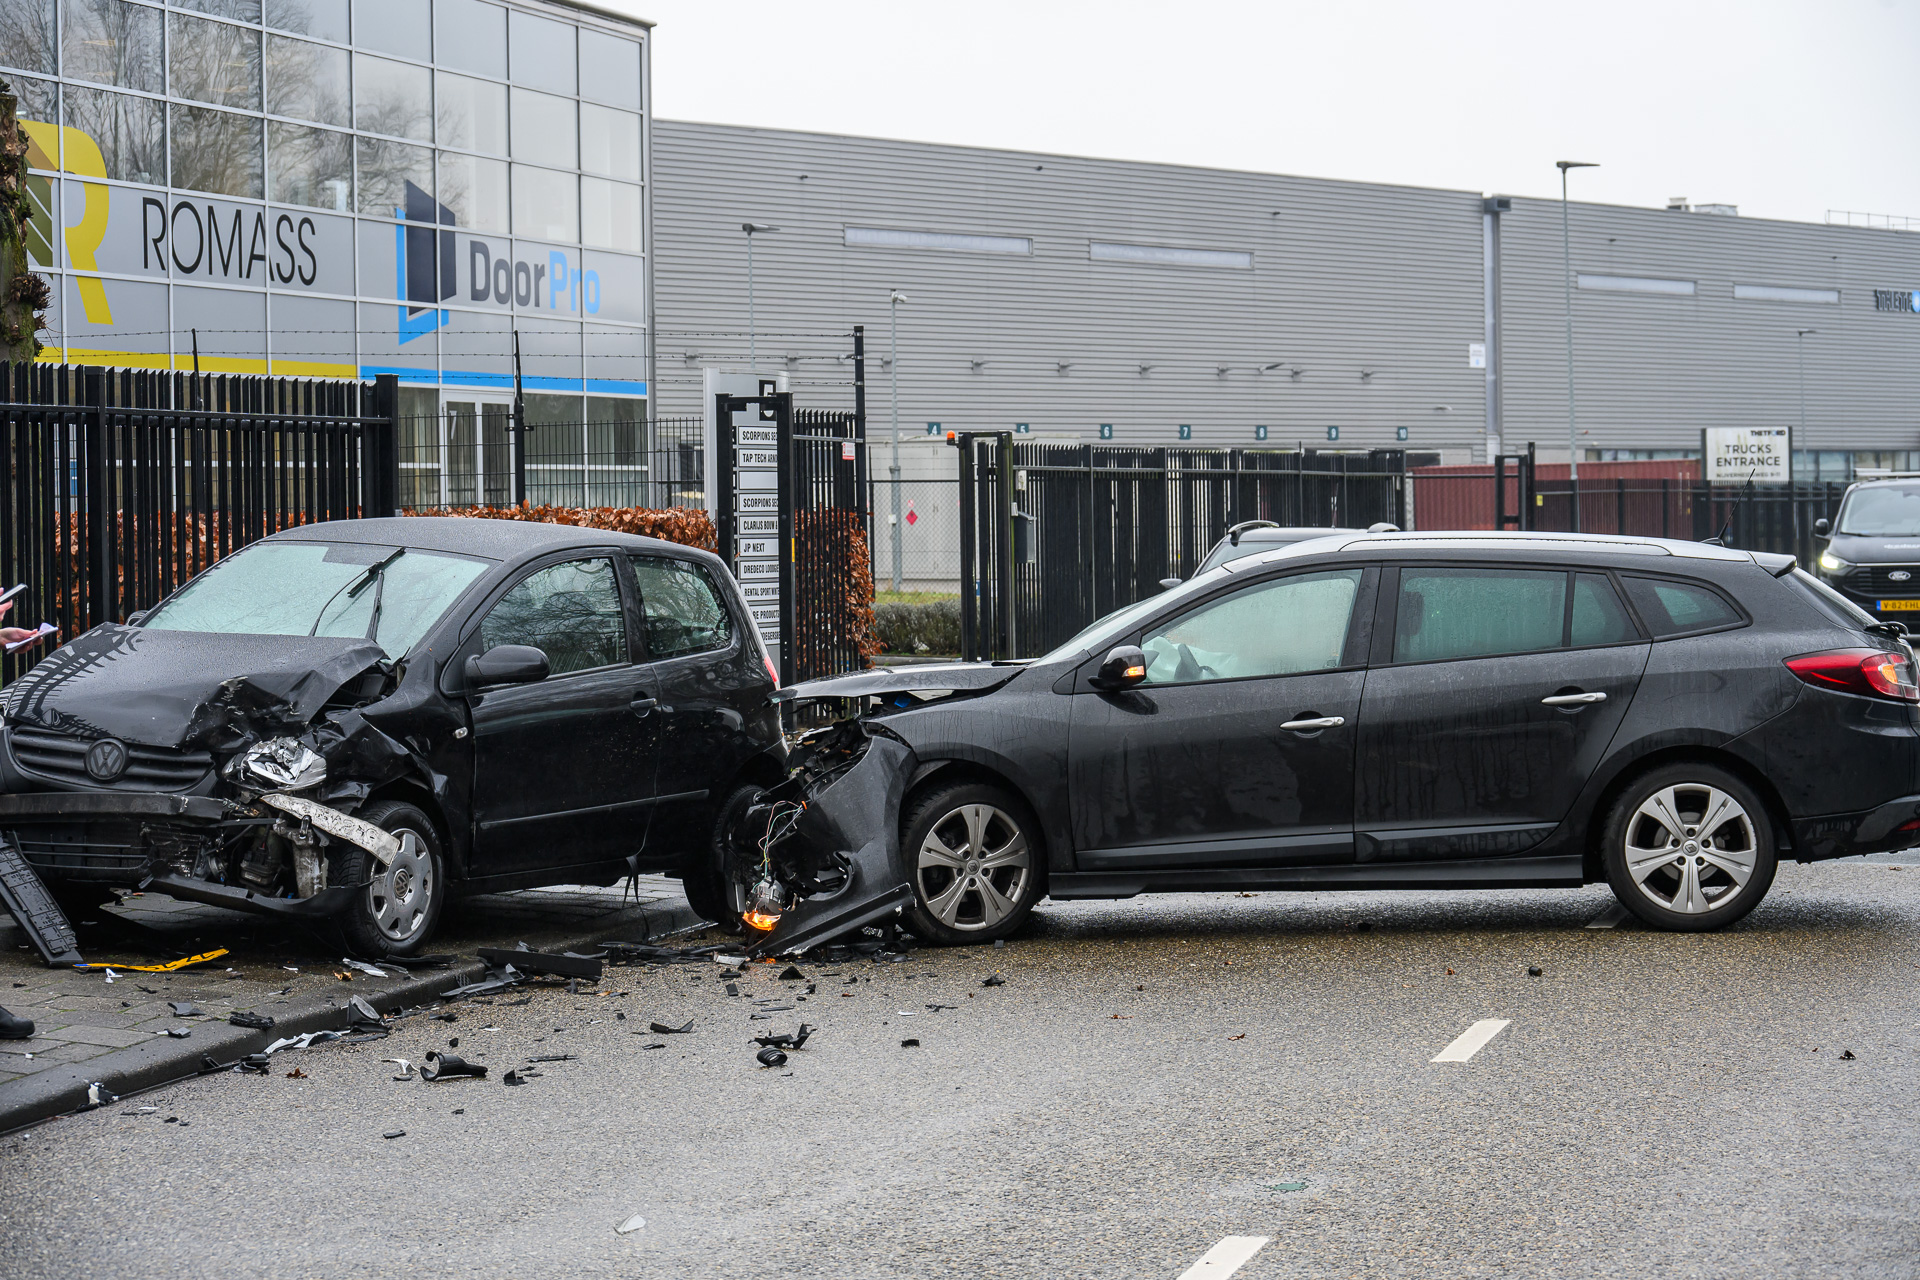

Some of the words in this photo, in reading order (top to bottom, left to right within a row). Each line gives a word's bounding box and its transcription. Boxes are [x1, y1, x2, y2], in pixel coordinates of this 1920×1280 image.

[142, 196, 317, 286] ROMASS
[742, 430, 771, 441] SCORPIONS
[930, 424, 938, 436] 4
[1104, 426, 1111, 437] 6
[1182, 426, 1189, 437] 7
[1259, 427, 1265, 438] 8
[1399, 428, 1407, 439] 10
[1725, 444, 1772, 454] TRUCKS
[742, 453, 753, 463] TAP
[754, 453, 767, 463] TECH
[1716, 456, 1781, 468] ENTRANCE
[743, 498, 772, 508] SCORPIONS
[743, 520, 763, 530] CLARIJS
[743, 543, 751, 553] JP
[752, 543, 765, 553] NEXT
[744, 588, 760, 597] RENTAL
